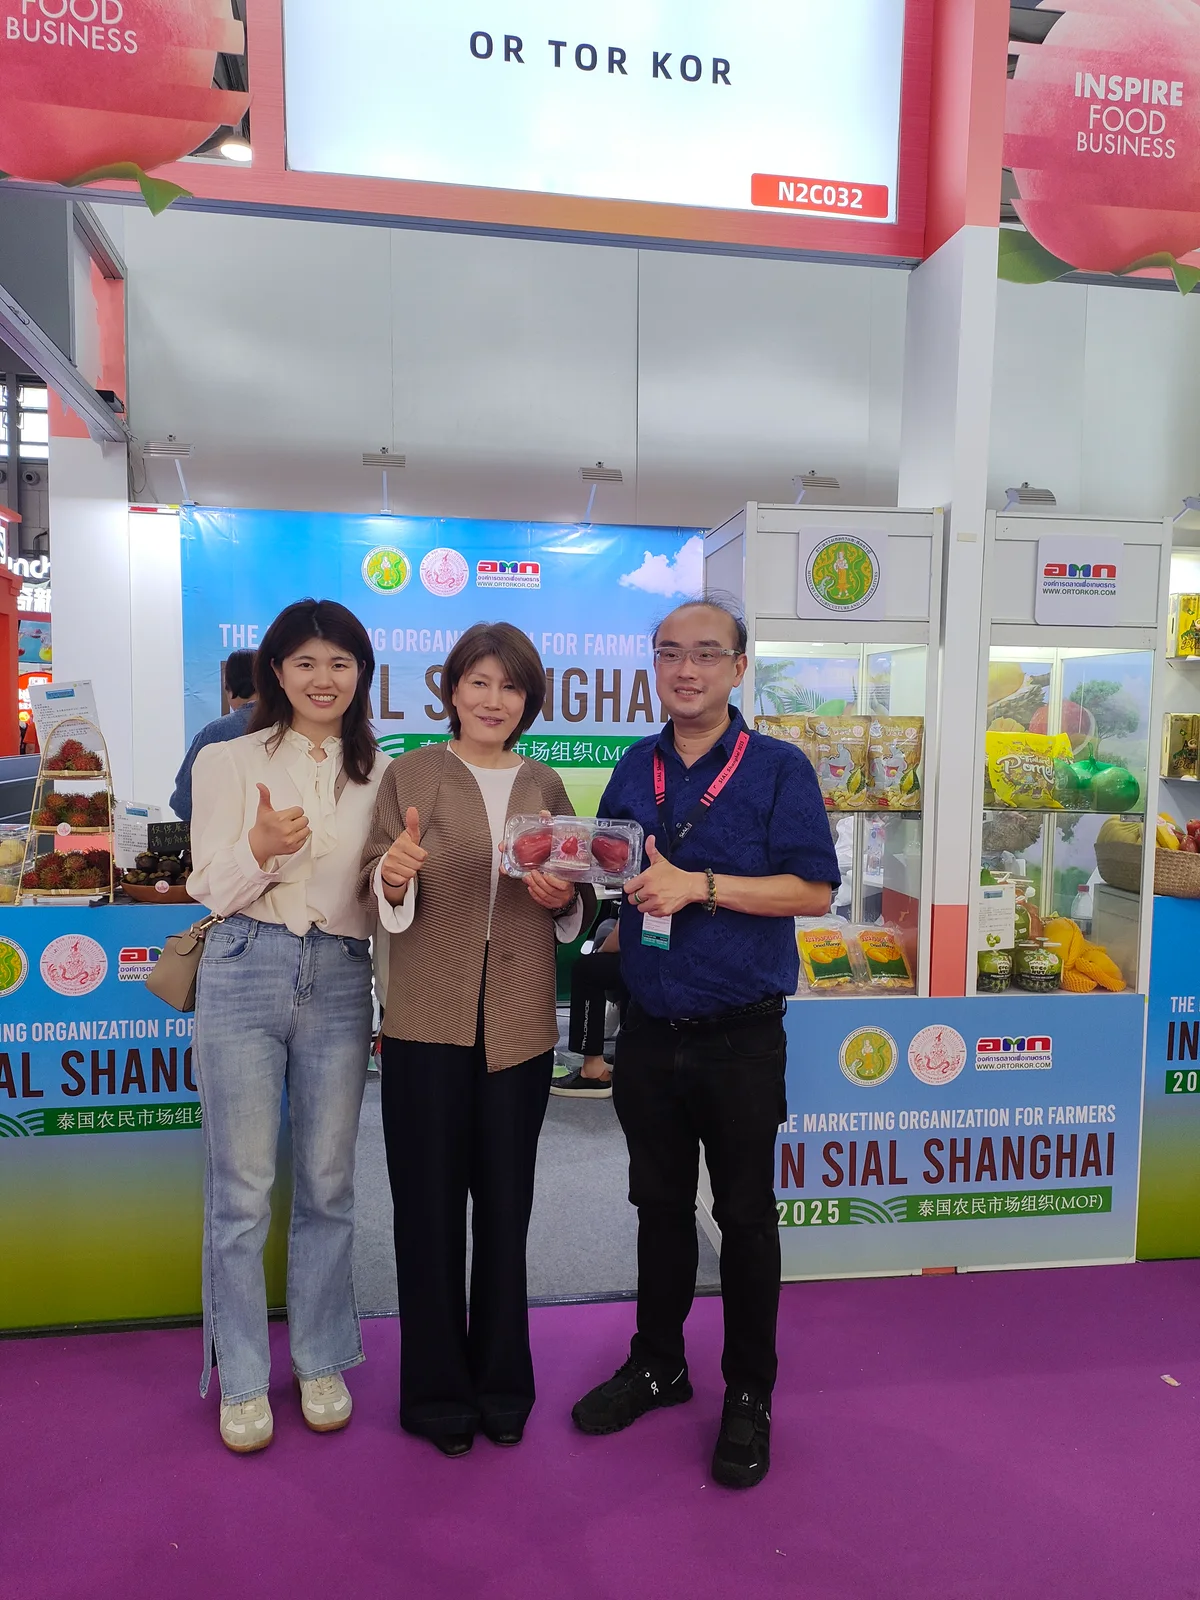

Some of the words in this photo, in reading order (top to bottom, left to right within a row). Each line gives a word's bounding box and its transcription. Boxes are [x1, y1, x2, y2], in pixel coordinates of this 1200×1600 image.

[22, 0, 123, 24] FOOD
[7, 16, 138, 54] BUSINESS
[470, 31, 525, 63] OR
[548, 40, 628, 75] TOR
[652, 51, 732, 85] KOR
[1075, 72, 1184, 107] INSPIRE
[1089, 104, 1166, 135] FOOD
[1077, 131, 1176, 159] BUSINESS
[778, 181, 863, 209] N2C032
[1042, 588, 1116, 596] WWW.ORTORKOR.COM
[219, 624, 259, 648] THE
[541, 633, 577, 655] FOR
[584, 634, 653, 657] FARME
[1170, 996, 1195, 1013] THE
[31, 1019, 159, 1042] ORGANIZATION
[165, 1018, 195, 1038] FOR
[1167, 1020, 1200, 1061] IN
[0, 1051, 44, 1099] AL
[61, 1047, 198, 1097] SHAN
[976, 1062, 1051, 1070] WWW.ORTORKOR.COM
[1172, 1071, 1198, 1093] 20
[57, 1106, 203, 1131] 泰国农民市场组
[778, 1114, 798, 1133] HE
[803, 1111, 895, 1133] MARKETING
[899, 1107, 1010, 1130] ORGANIZATION
[1014, 1106, 1044, 1127] FOR
[1048, 1104, 1116, 1125] FARMERS
[772, 1142, 805, 1189] N
[821, 1140, 908, 1188] SIAL
[923, 1131, 1116, 1185] SHANGHAI
[776, 1200, 840, 1226] 2025
[917, 1193, 1104, 1218] 泰国农民市场组织(MOF)
